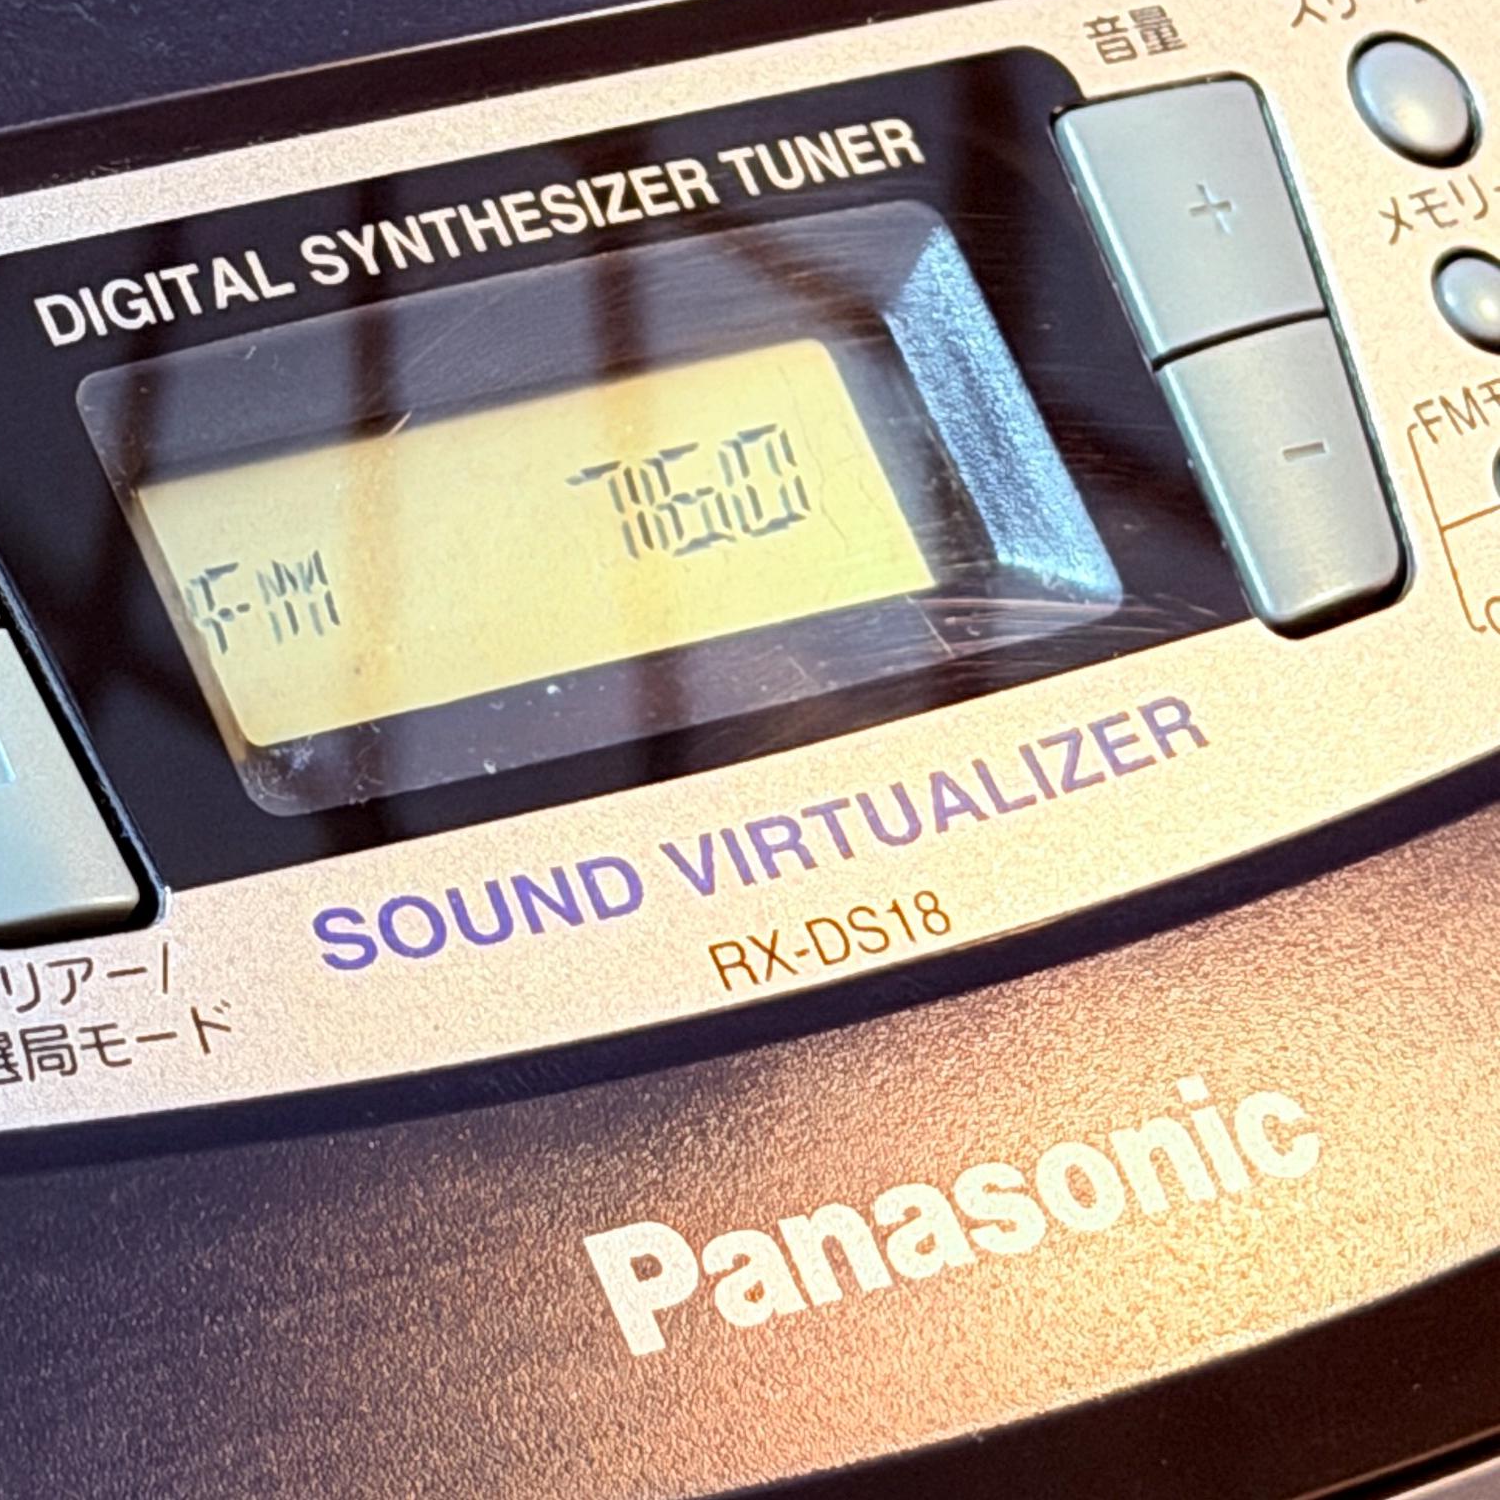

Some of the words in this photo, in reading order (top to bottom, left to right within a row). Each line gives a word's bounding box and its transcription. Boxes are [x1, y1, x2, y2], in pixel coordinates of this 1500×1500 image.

[1083, 4, 1188, 65] 音量
[34, 246, 296, 347] DIGITAL
[300, 156, 717, 286] SYNTHESIZER
[717, 117, 926, 199] TUNER
[1379, 173, 1500, 246] メモリ
[312, 854, 644, 971] SOUND
[660, 695, 1211, 896] VIRTUALIZER
[708, 890, 952, 992] RX-DS18
[583, 1075, 1321, 1356] Panasonic
